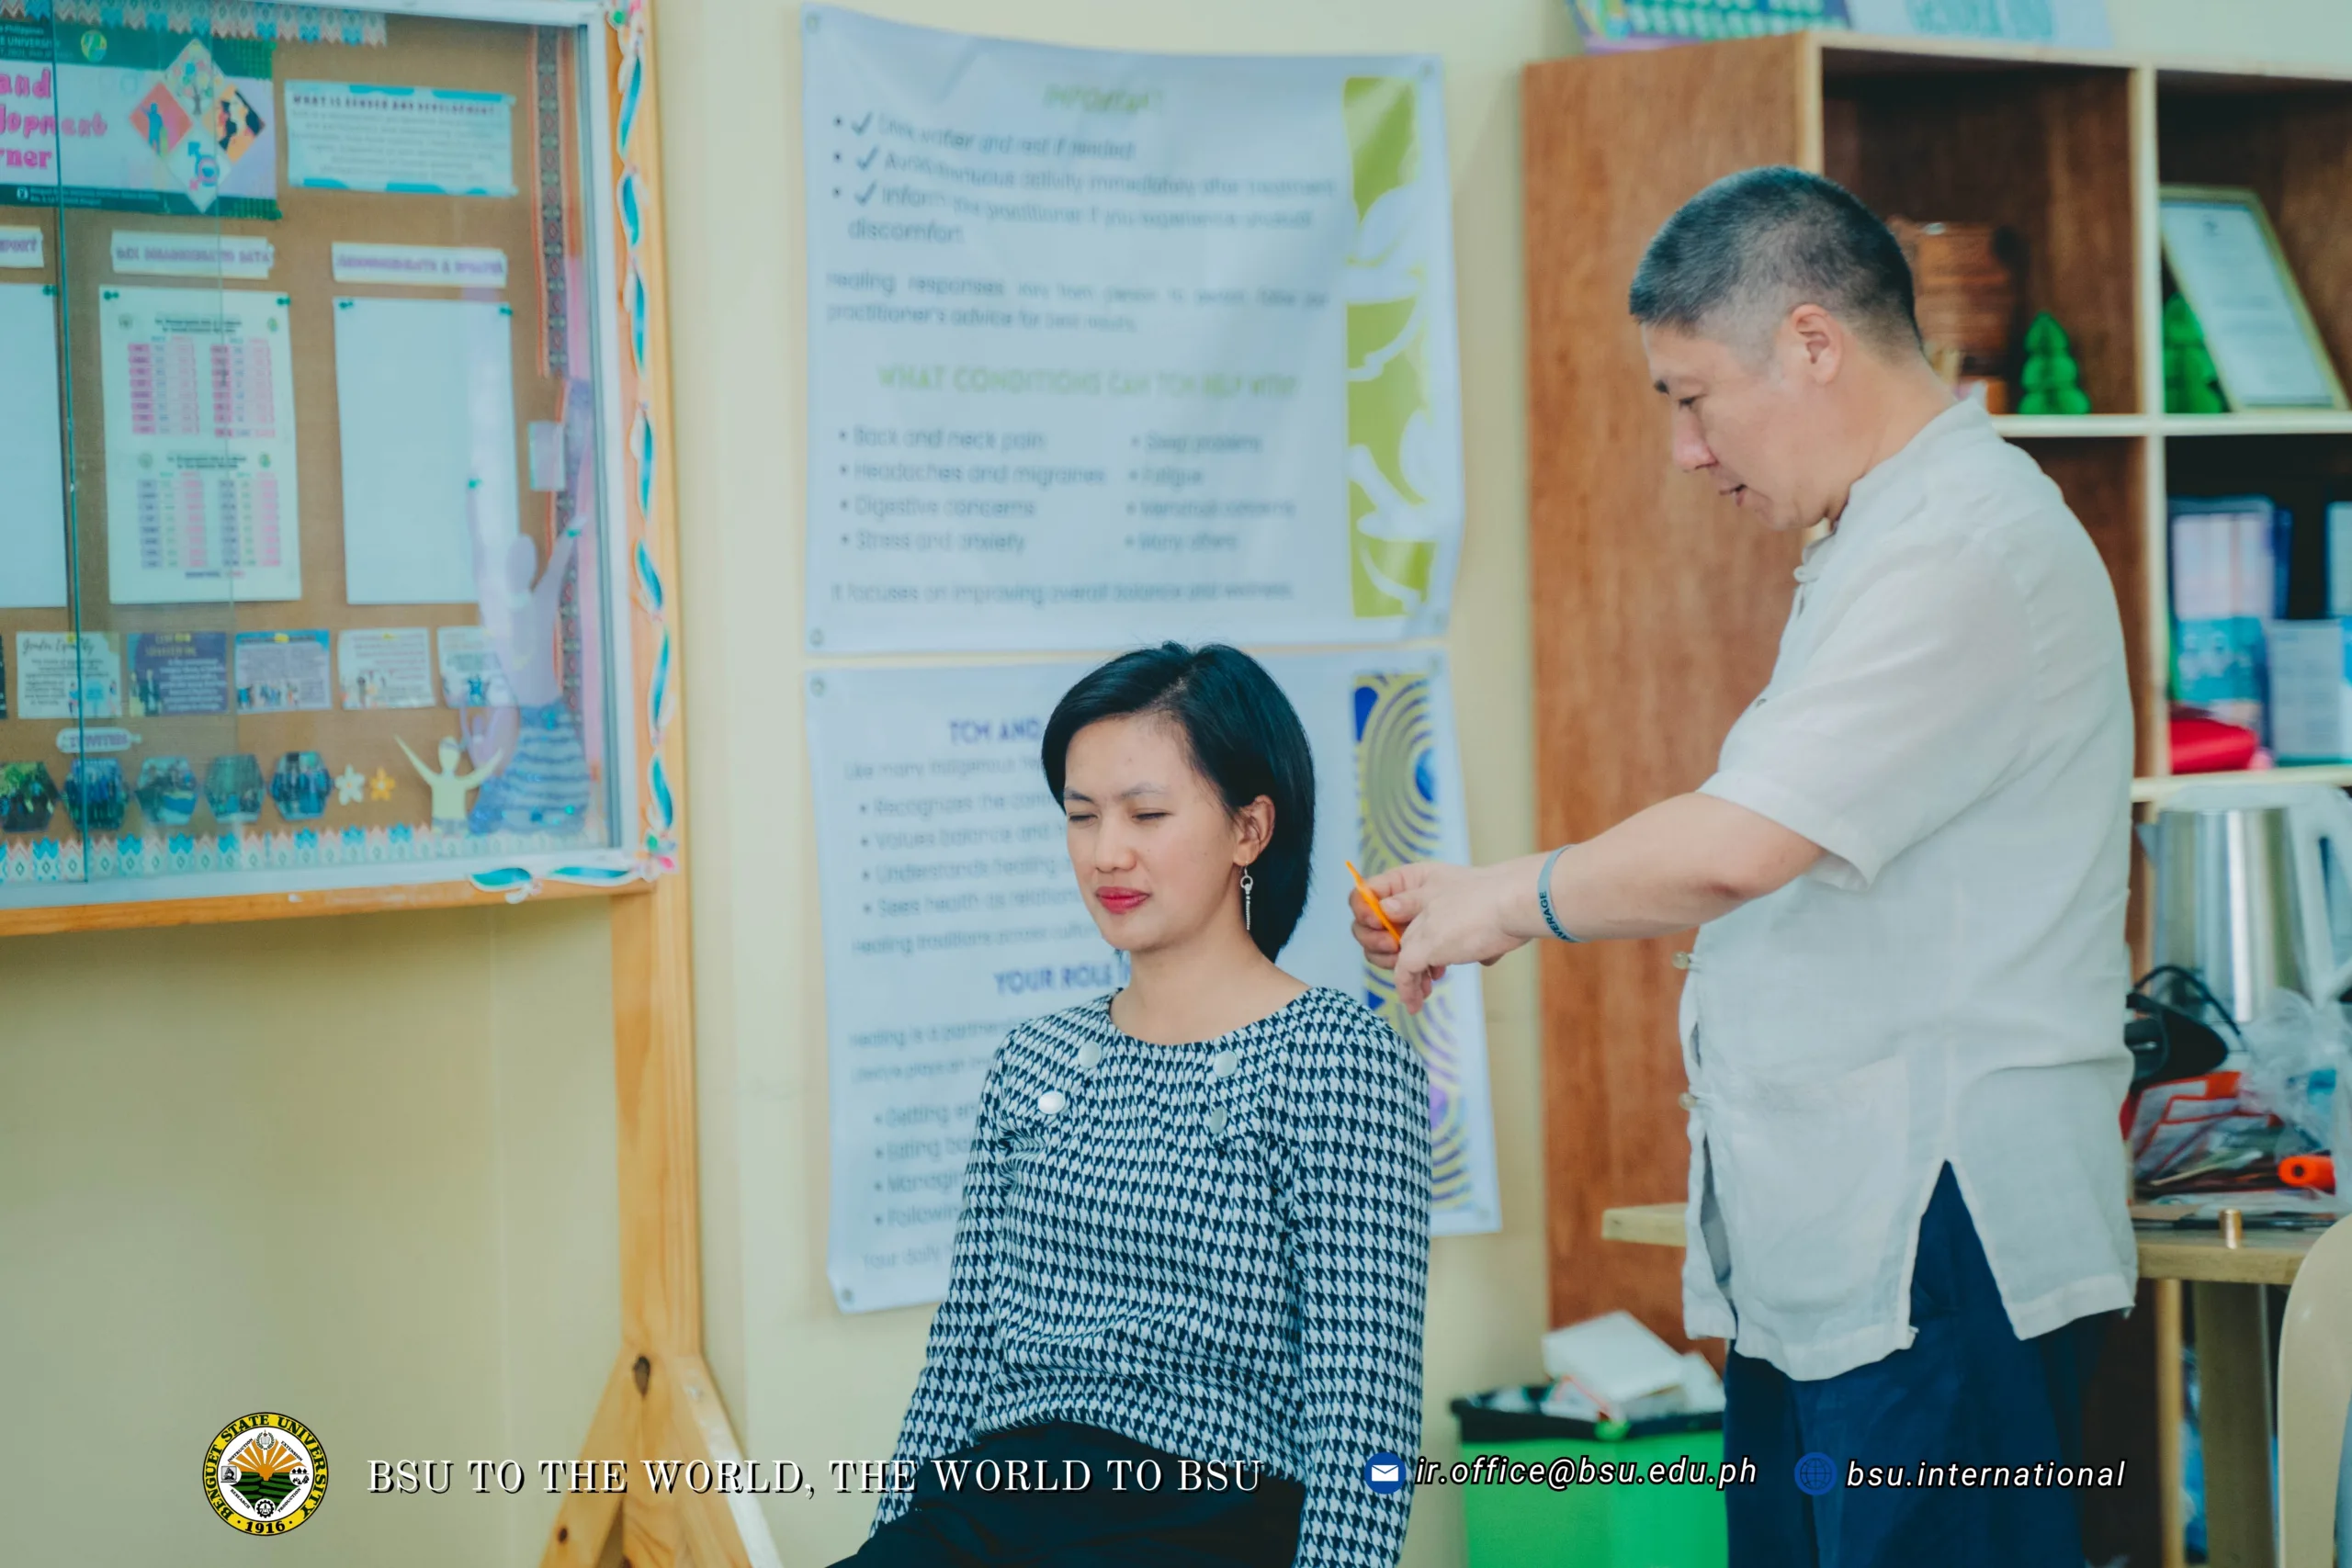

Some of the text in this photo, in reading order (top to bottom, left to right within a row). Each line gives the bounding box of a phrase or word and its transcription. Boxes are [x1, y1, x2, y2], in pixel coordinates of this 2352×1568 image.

[902, 427, 944, 448] and
[967, 463, 1008, 483] and
[1539, 890, 1571, 941] AVERAGE
[993, 967, 1053, 995] YOUR
